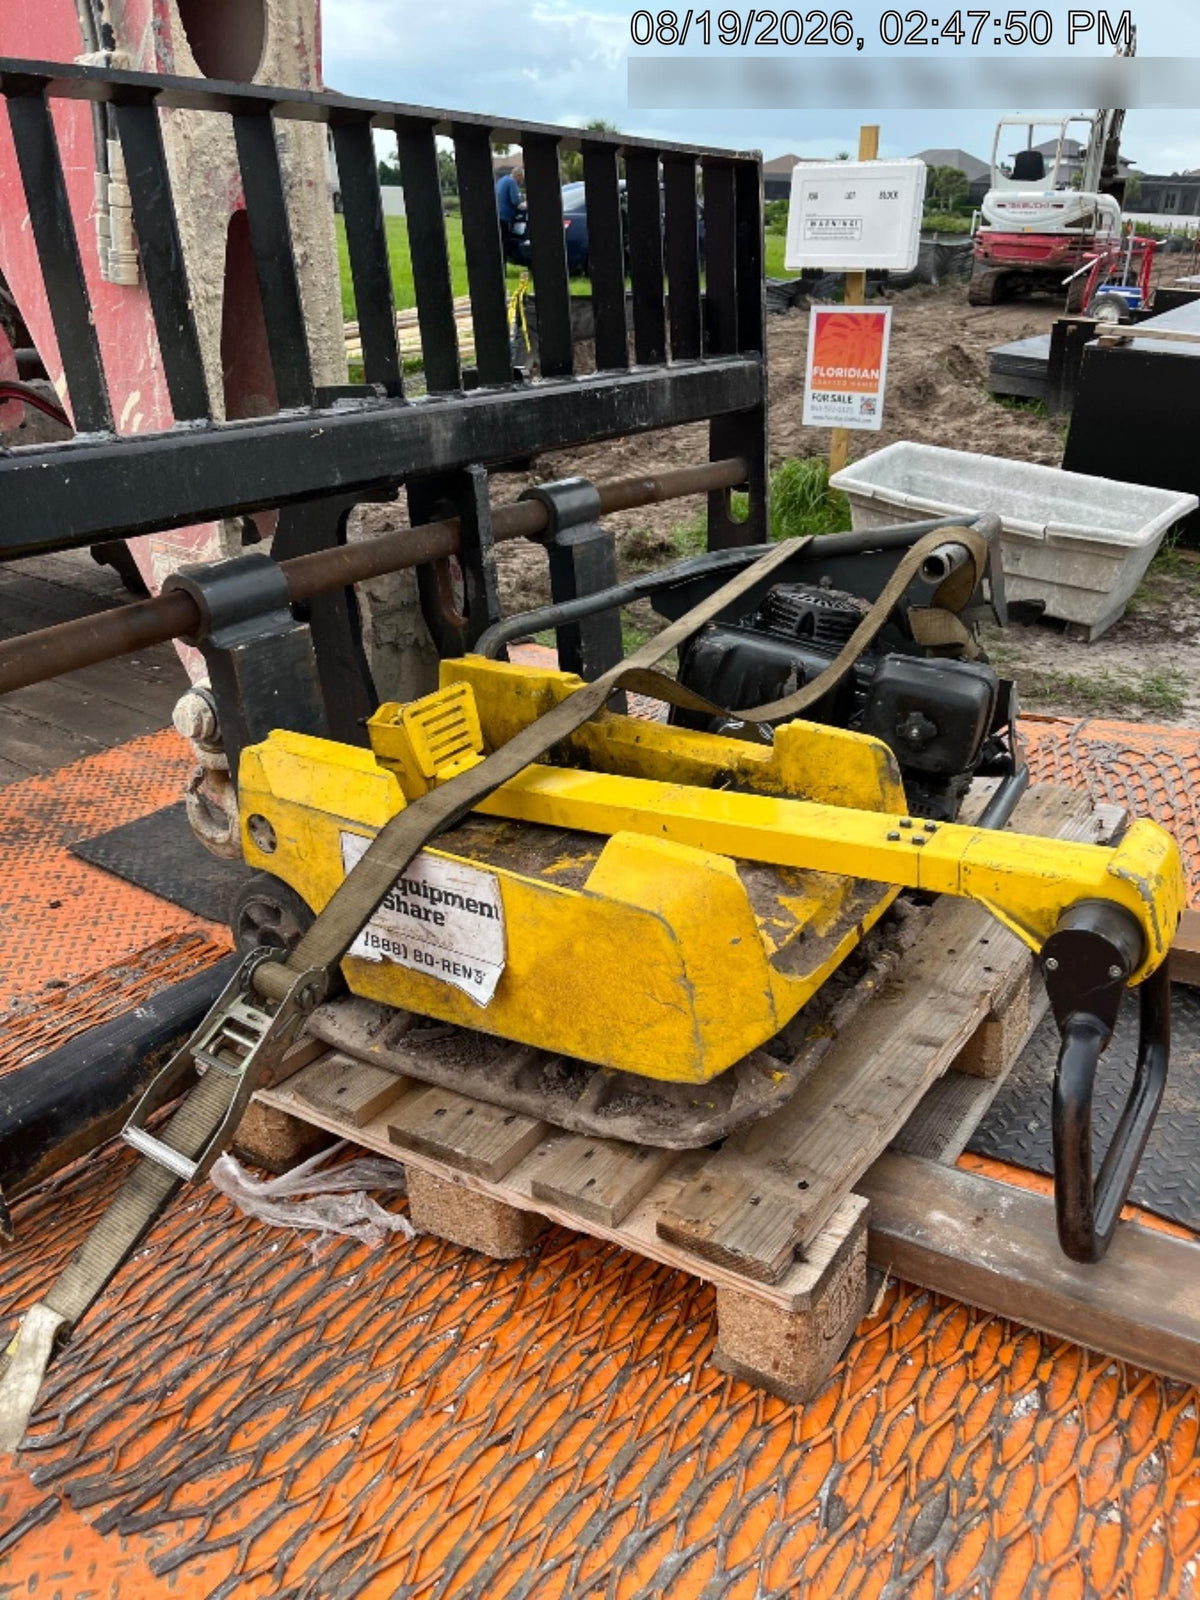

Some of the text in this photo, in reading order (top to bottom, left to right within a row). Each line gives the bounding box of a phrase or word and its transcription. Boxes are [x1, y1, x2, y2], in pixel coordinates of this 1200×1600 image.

[813, 366, 879, 379] FLORIDIAN
[812, 392, 852, 404] FOR SALE
[383, 889, 446, 927] Share
[395, 878, 500, 921] quipmen
